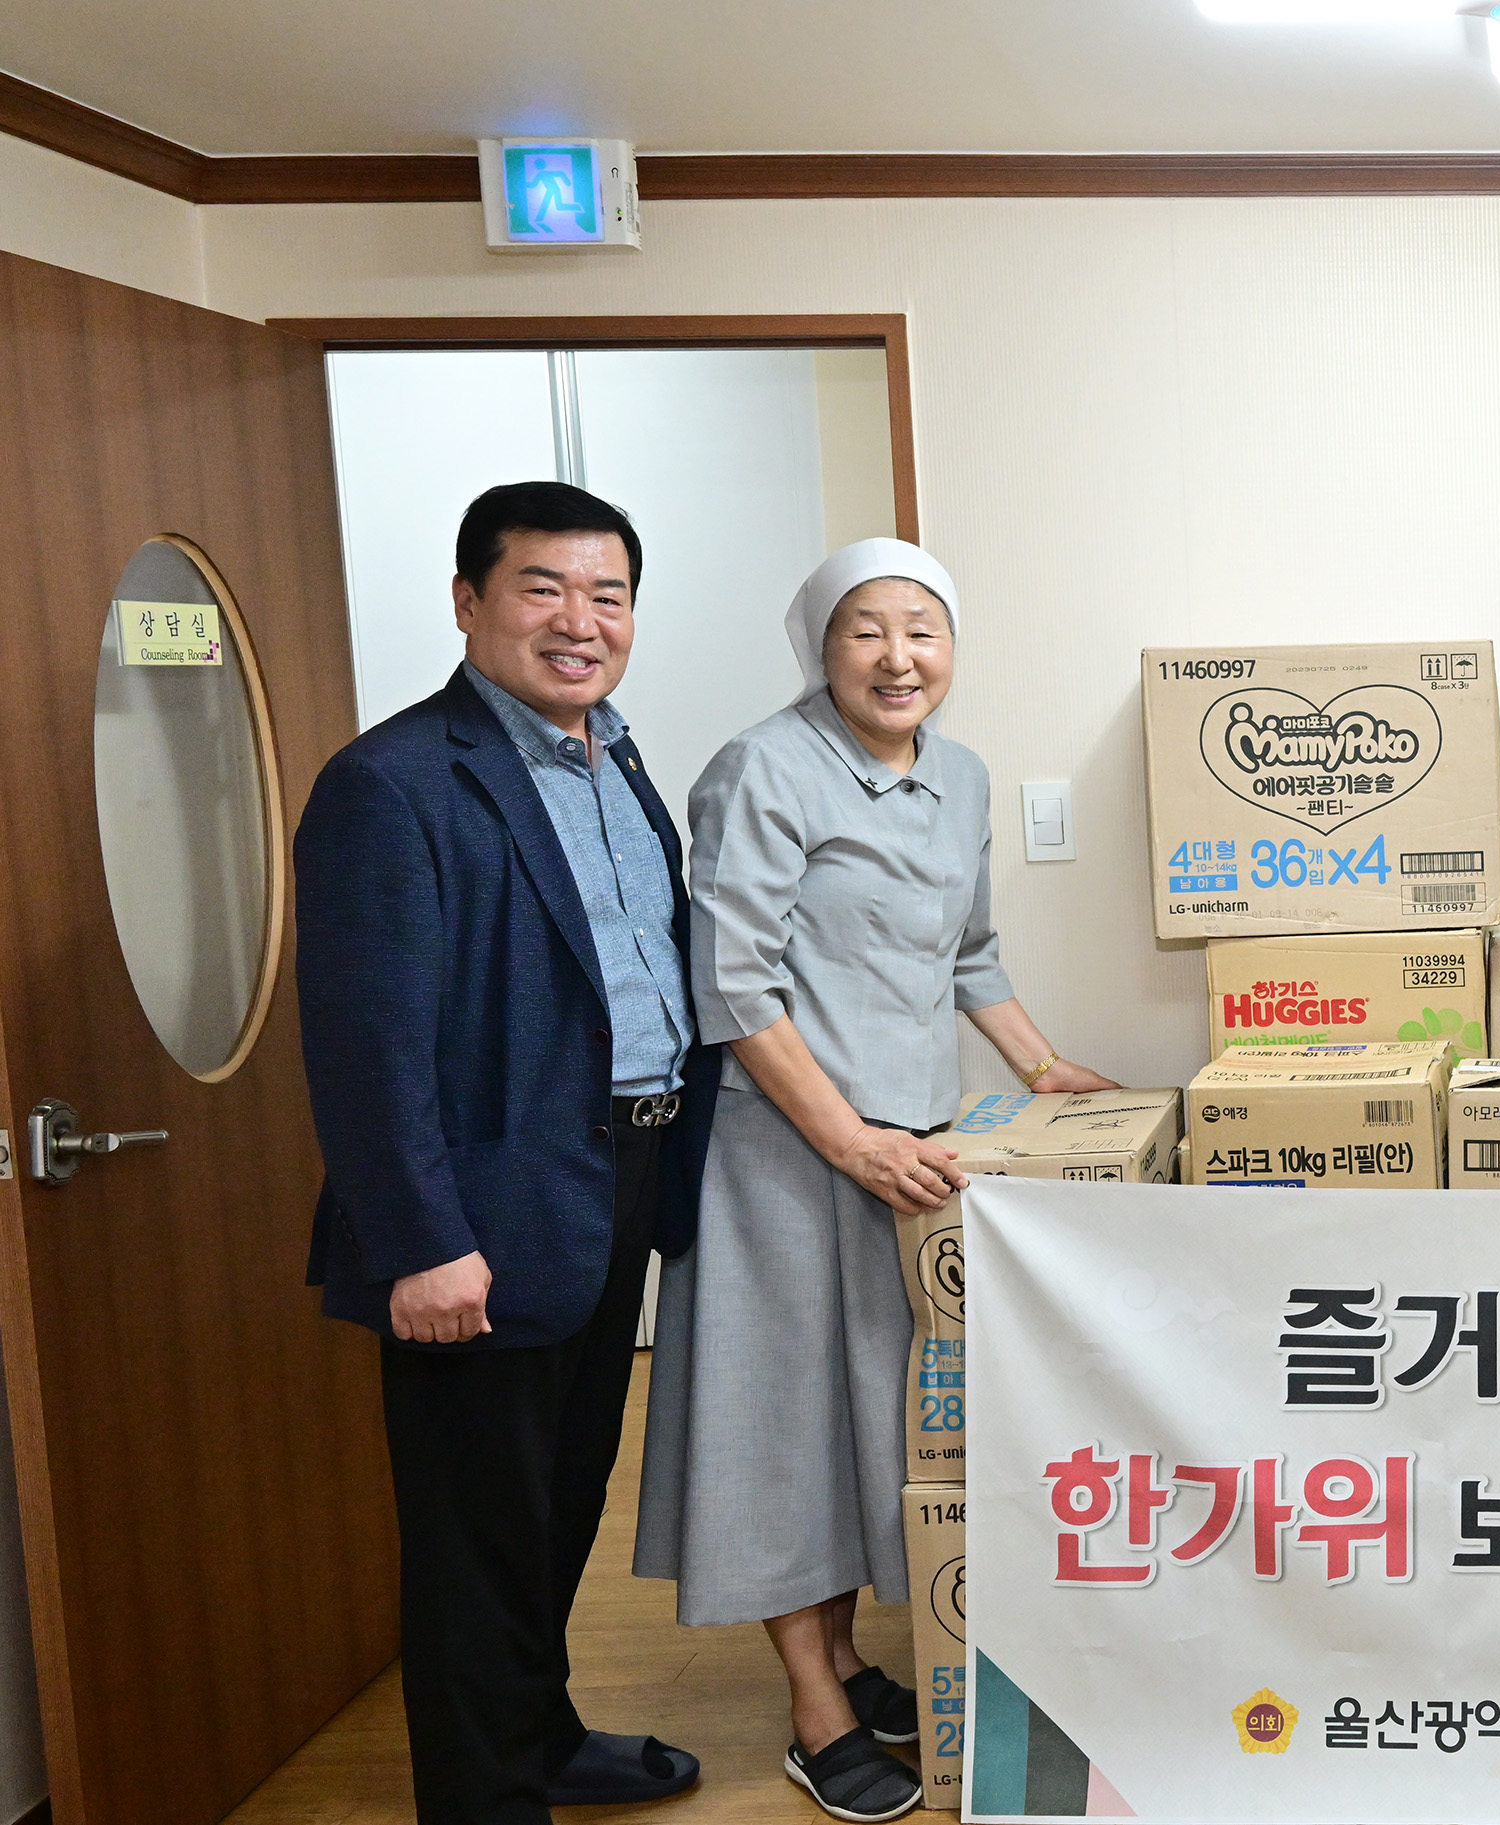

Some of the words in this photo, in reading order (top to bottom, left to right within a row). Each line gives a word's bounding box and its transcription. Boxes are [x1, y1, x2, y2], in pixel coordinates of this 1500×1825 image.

[139, 611, 206, 638] 상담실
[141, 648, 184, 663] Counseling
[1159, 660, 1256, 680] 11460997
[1282, 715, 1331, 730] 마이포코
[1225, 703, 1420, 774] MamyPoko
[1252, 773, 1395, 797] 에어핏공기솔솔
[1193, 840, 1236, 861] 대형
[1195, 863, 1238, 873] 10~14kg
[1412, 902, 1474, 913] 11460997
[1402, 954, 1466, 967] 11039994
[1411, 970, 1458, 986] 34229
[1251, 981, 1318, 999] 하기스
[1223, 994, 1368, 1029] HUGGIES
[1222, 1106, 1248, 1120] 애경
[1206, 1147, 1273, 1176] 스파크
[1277, 1146, 1326, 1177] 10kg
[1332, 1142, 1414, 1175] 리필(안)
[920, 1394, 965, 1432] 28
[920, 1502, 966, 1525] 1146
[1044, 1443, 1414, 1584] 한가위
[1247, 1714, 1281, 1731] 의회
